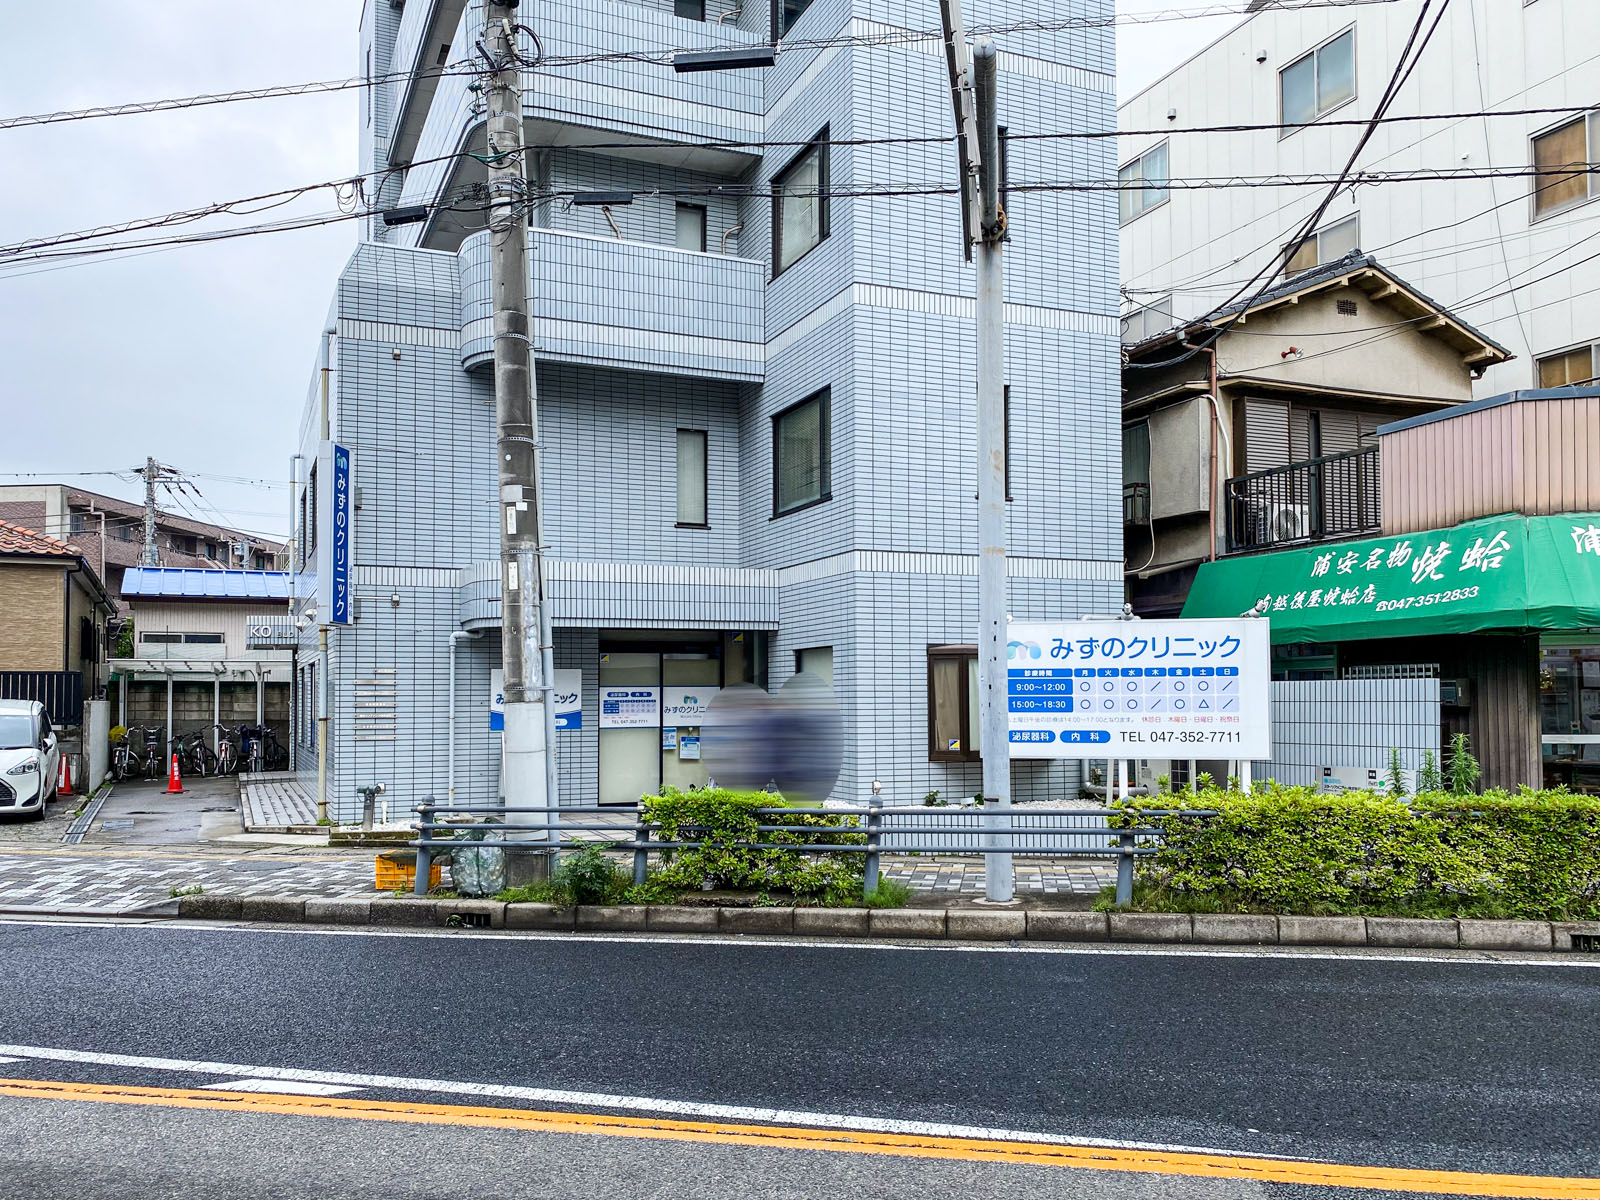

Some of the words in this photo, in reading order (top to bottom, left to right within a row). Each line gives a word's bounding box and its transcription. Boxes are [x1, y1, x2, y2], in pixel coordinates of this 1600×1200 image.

[336, 473, 346, 616] みずのクリニック
[1310, 540, 1413, 578] 浦安名物
[1411, 530, 1511, 585] 焼蛤
[250, 625, 272, 639] KO
[1049, 635, 1241, 660] みずのクリニック
[1024, 669, 1053, 677] 診療時間
[1081, 669, 1089, 677] 月
[1104, 669, 1113, 677] 火
[1151, 668, 1160, 676] 木
[1175, 668, 1183, 676] 金
[1199, 668, 1207, 676] 土
[1223, 668, 1231, 676] 日
[1011, 731, 1050, 742] 泌尿器科
[1120, 731, 1146, 742] TEL
[1149, 731, 1240, 743] 047-352-7711
